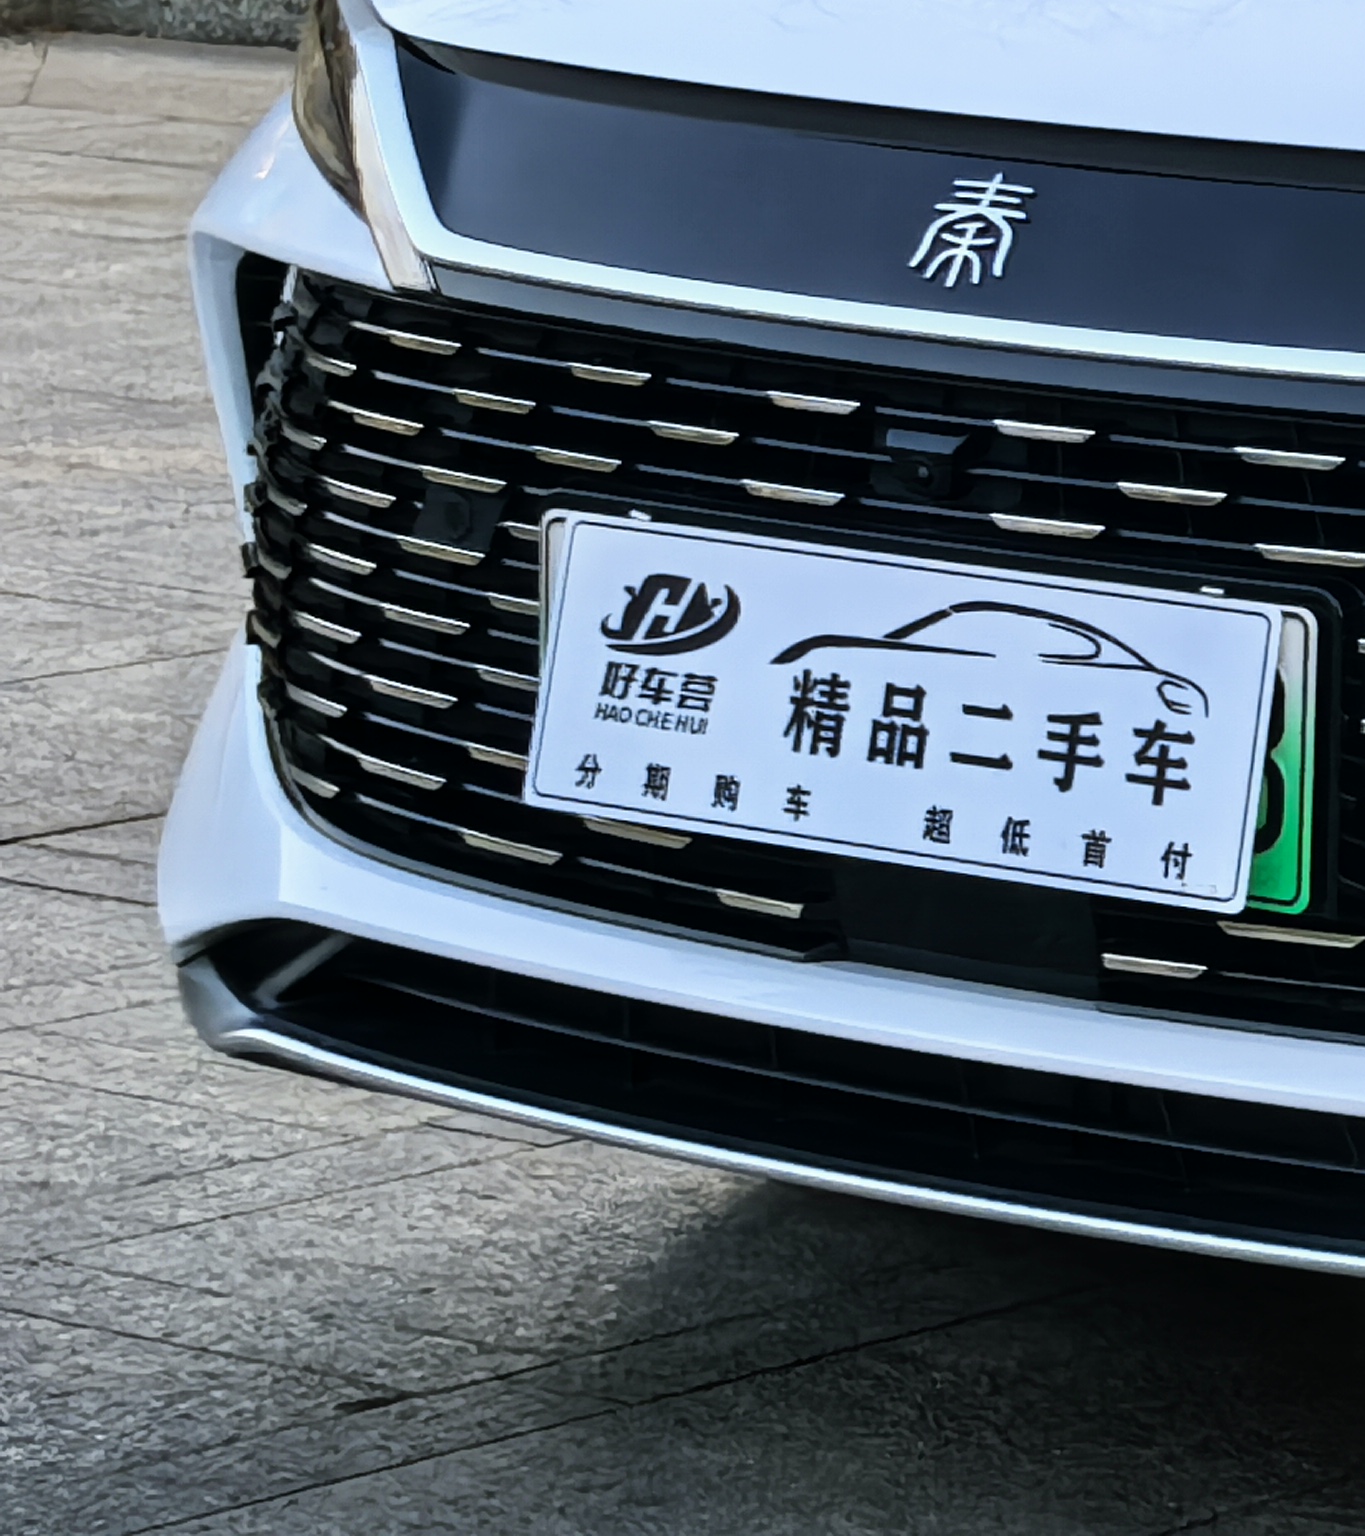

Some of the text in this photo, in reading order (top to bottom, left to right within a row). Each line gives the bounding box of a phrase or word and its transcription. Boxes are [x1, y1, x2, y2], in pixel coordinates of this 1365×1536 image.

[594, 702, 709, 736] HAO CHE HUI
[783, 668, 1196, 807] 精品二手车
[575, 753, 1193, 880] 分期购车 超低首付
